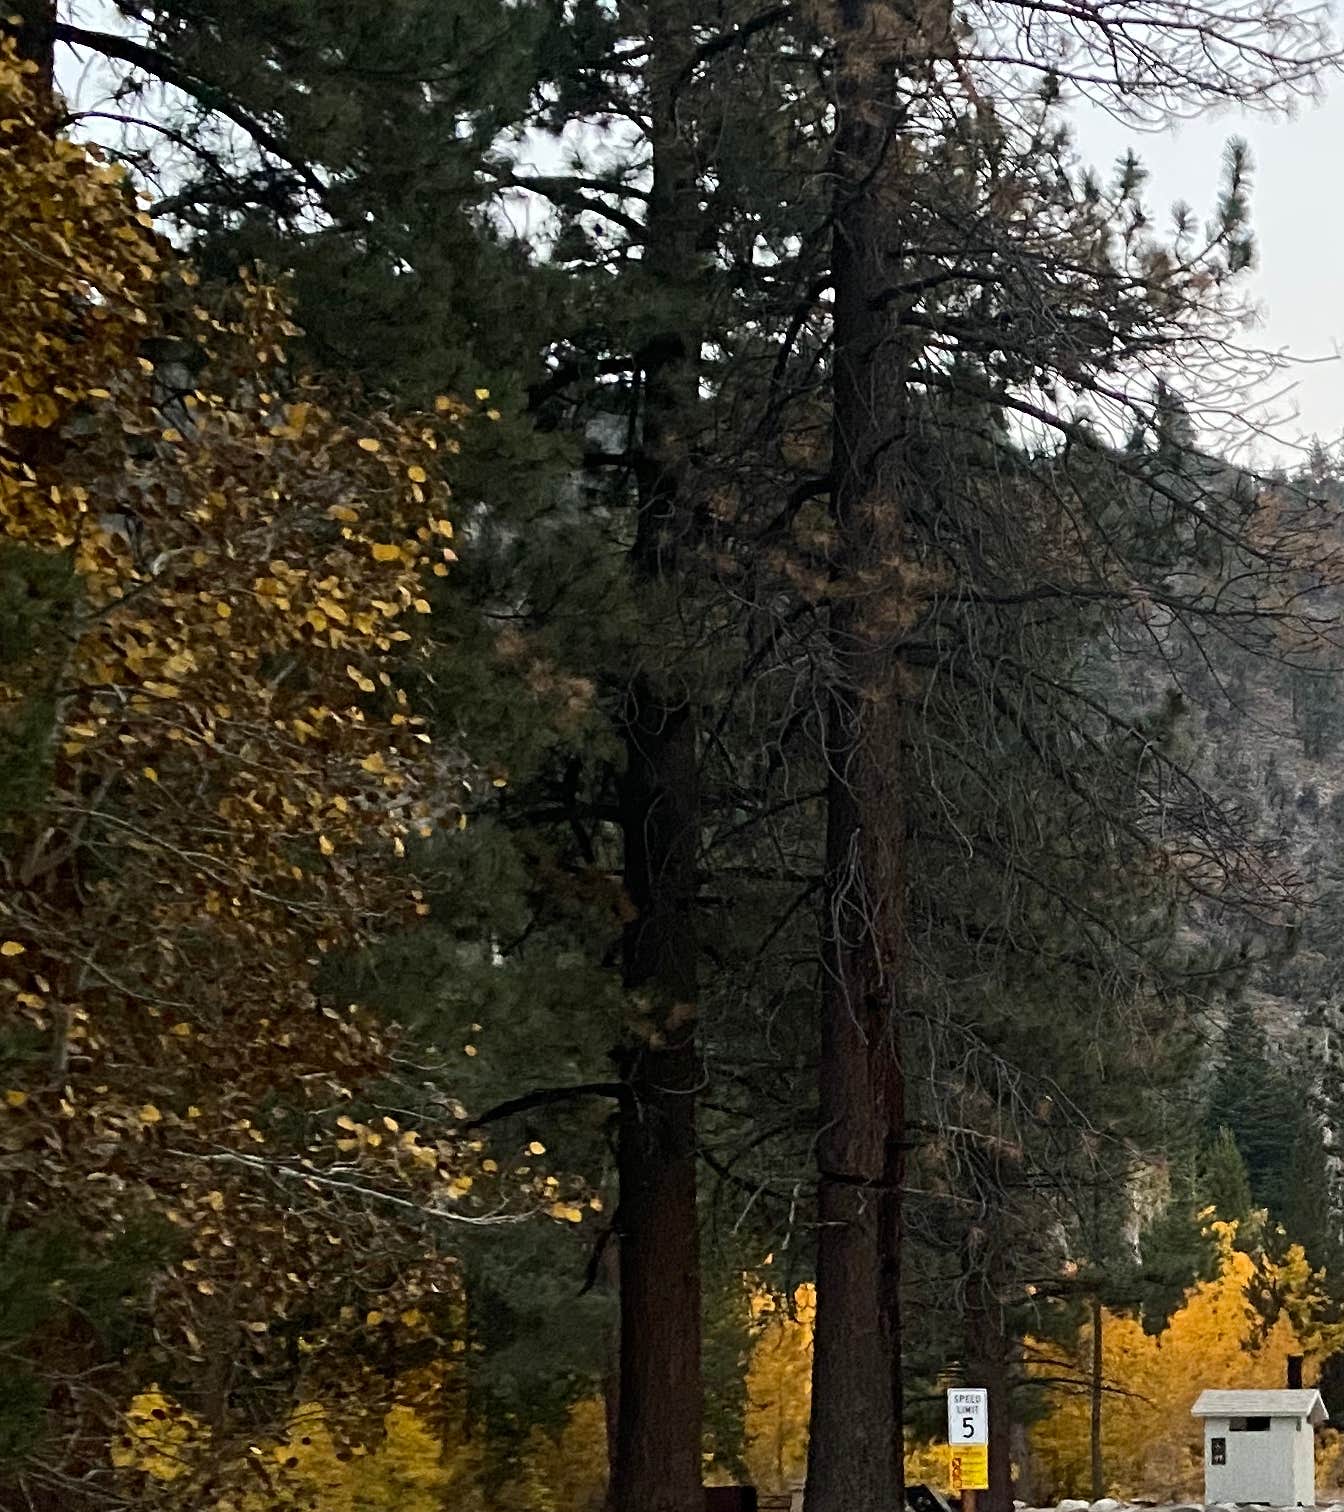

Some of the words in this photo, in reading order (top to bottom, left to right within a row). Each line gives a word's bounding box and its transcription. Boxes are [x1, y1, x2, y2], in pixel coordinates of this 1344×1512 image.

[954, 1394, 981, 1404] SPEED
[956, 1405, 979, 1414] LIMIT
[962, 1417, 975, 1438] 5
